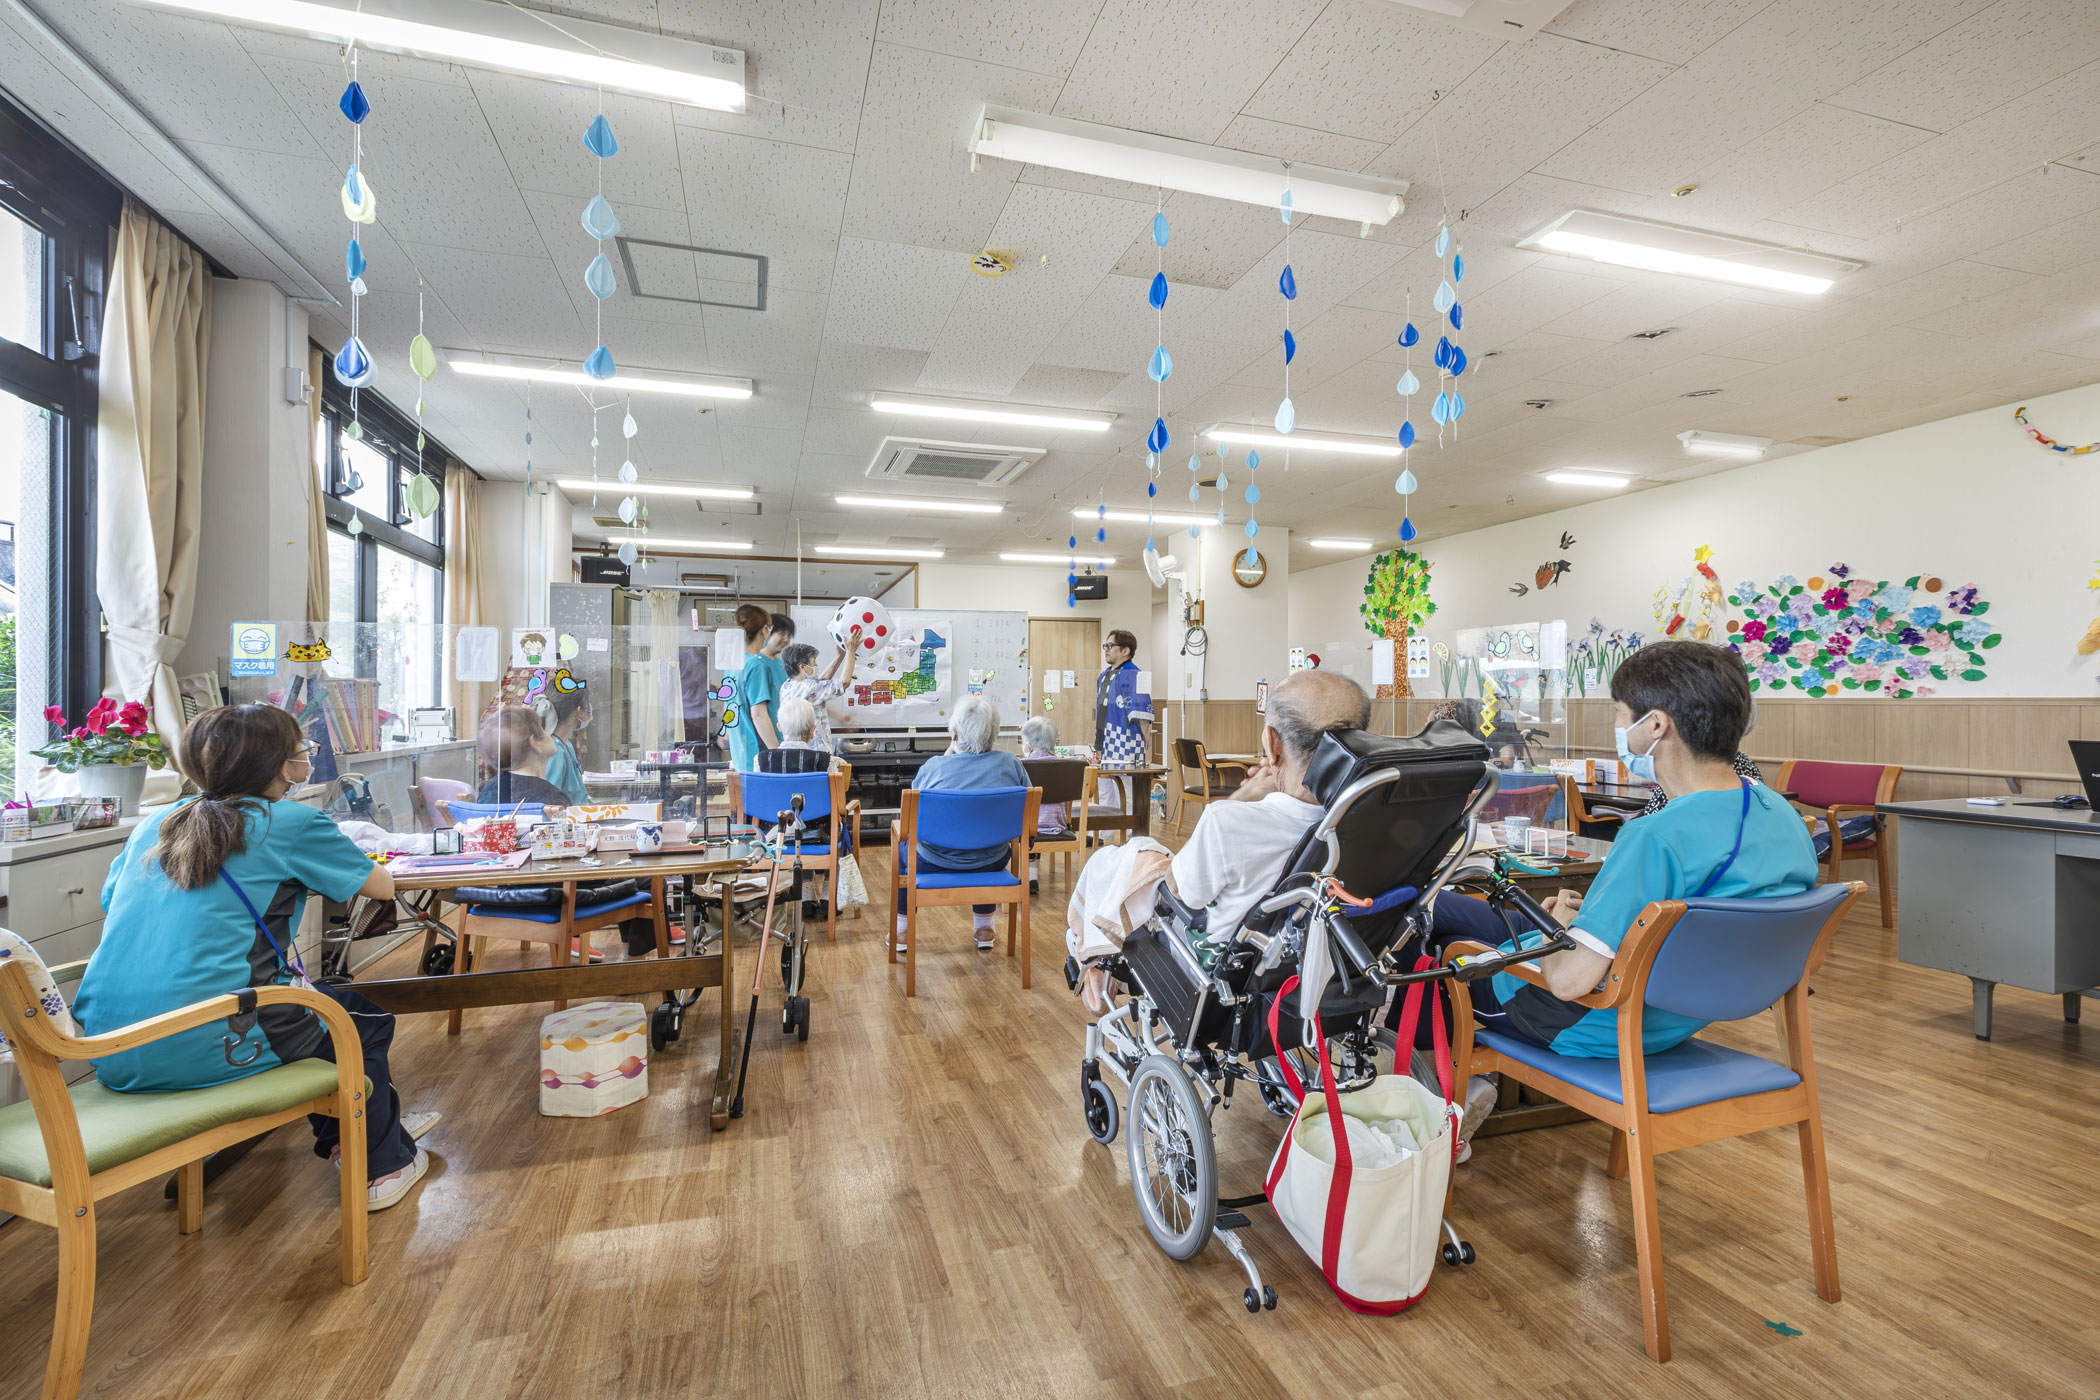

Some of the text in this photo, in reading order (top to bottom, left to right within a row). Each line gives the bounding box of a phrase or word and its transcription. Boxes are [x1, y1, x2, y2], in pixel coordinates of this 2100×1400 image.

[233, 661, 275, 670] マスク着用
